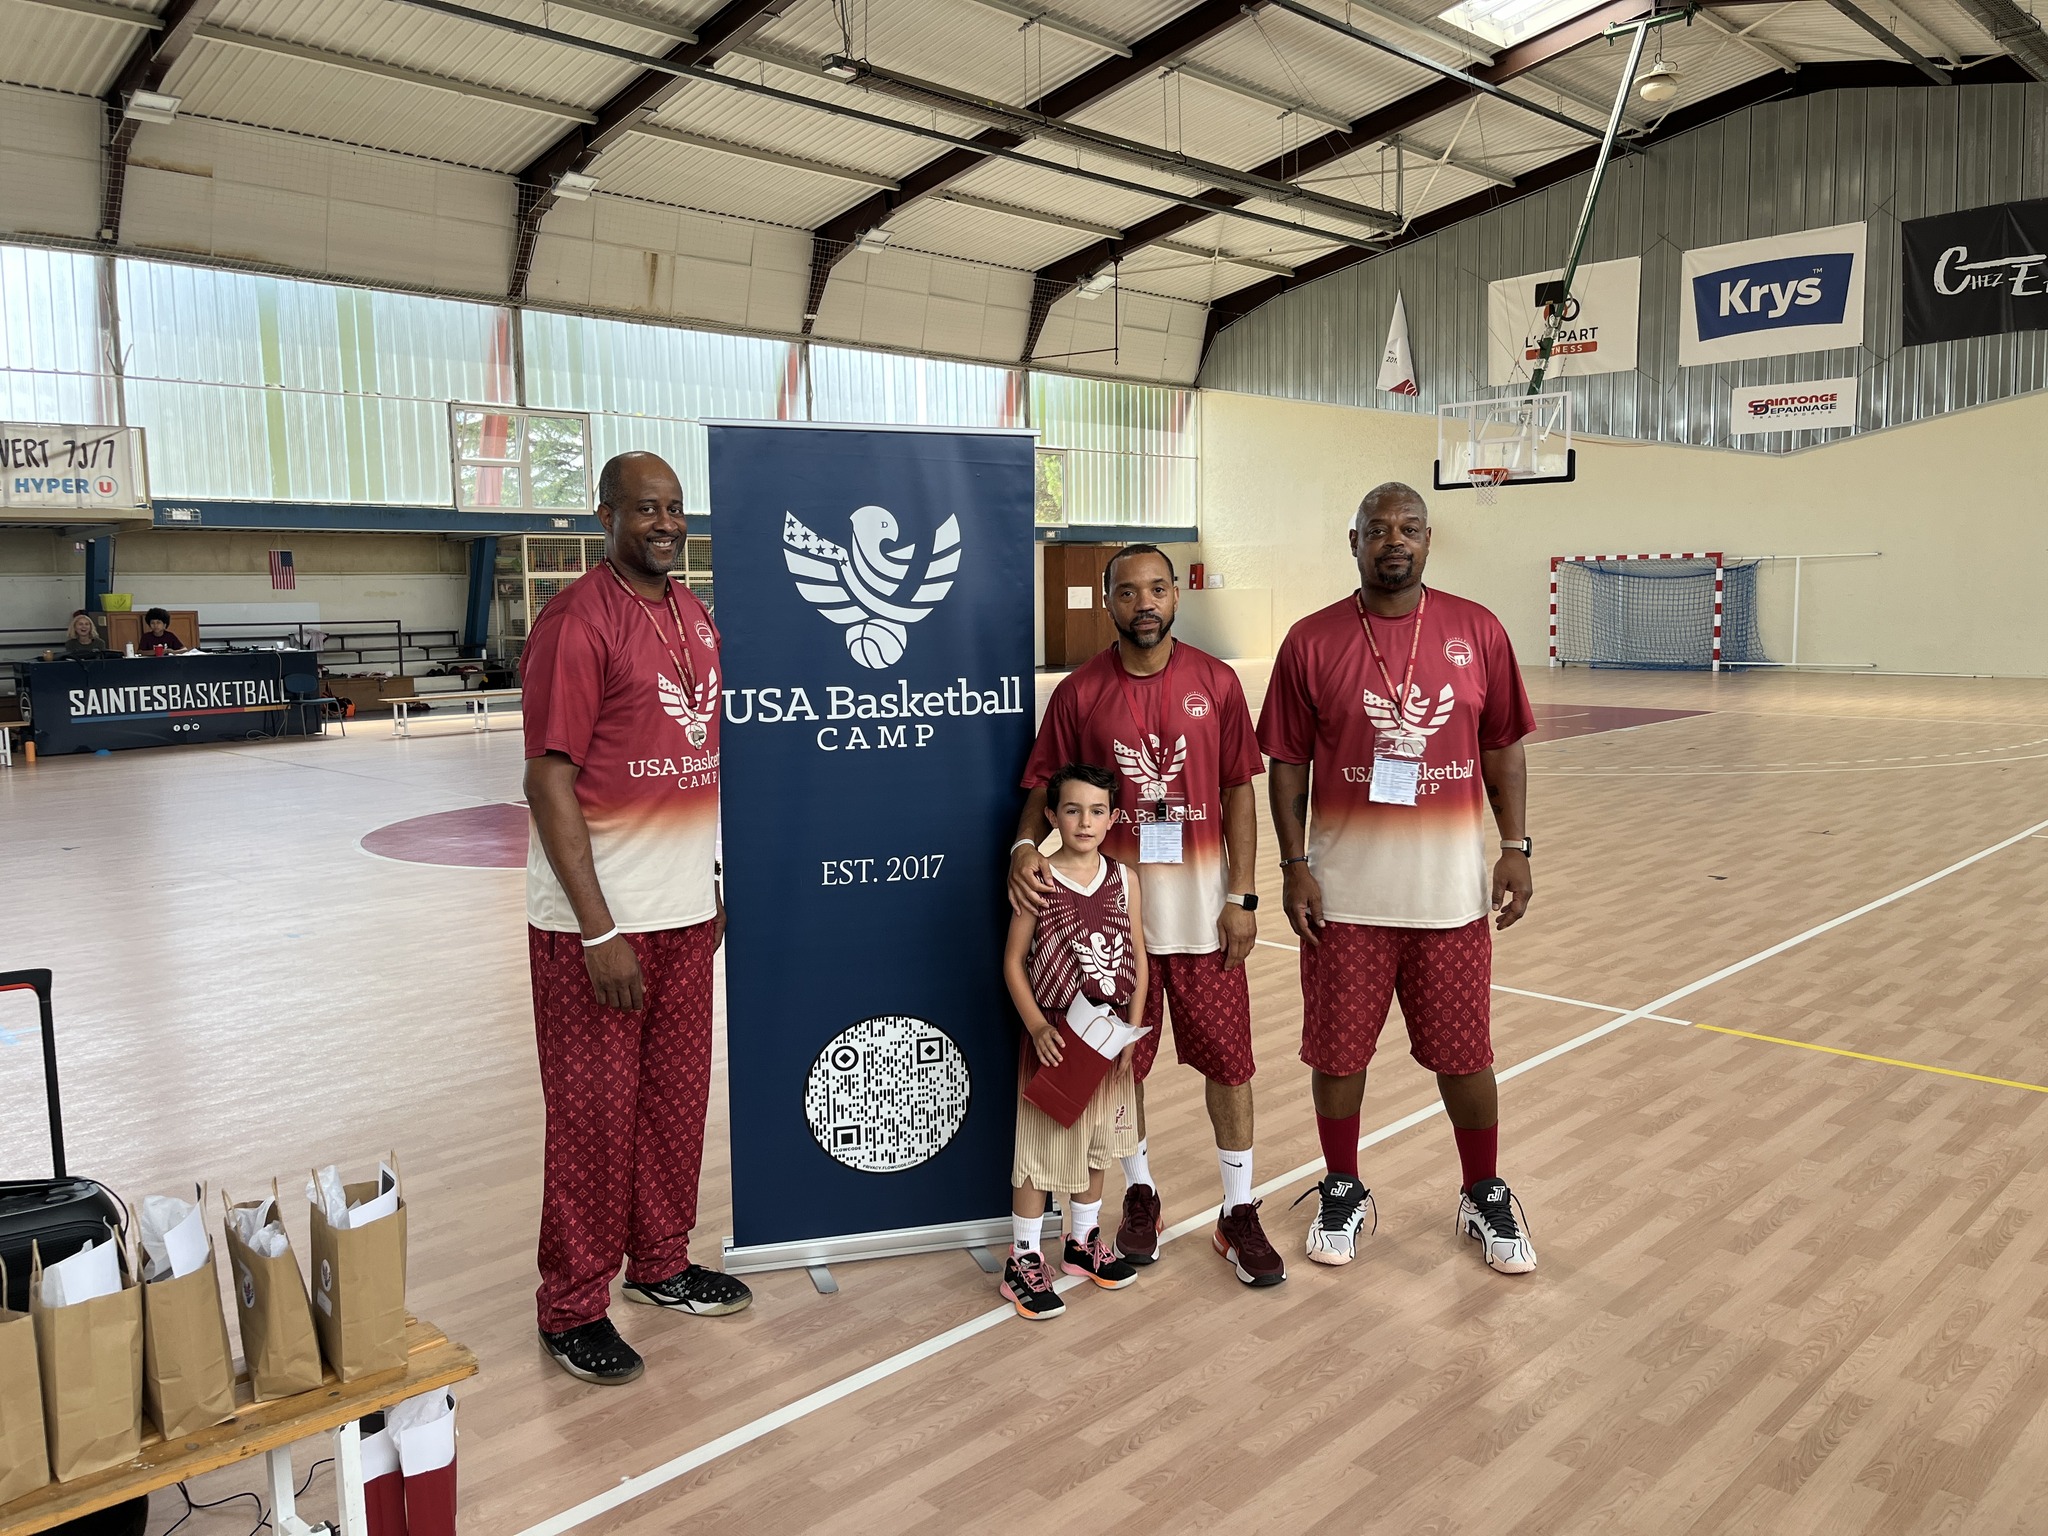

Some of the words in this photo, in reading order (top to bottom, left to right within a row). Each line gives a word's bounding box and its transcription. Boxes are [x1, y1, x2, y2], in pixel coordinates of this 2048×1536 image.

[1719, 277, 1822, 319] Krys
[1525, 326, 1599, 348] L'PART
[14, 478, 90, 494] HYPER
[721, 687, 819, 724] USA
[826, 676, 1024, 720] Basketball
[816, 724, 935, 751] CAMP
[627, 757, 679, 778] USA
[677, 771, 717, 789] CAMP
[821, 858, 878, 886] EST.
[886, 854, 945, 882] 2017
